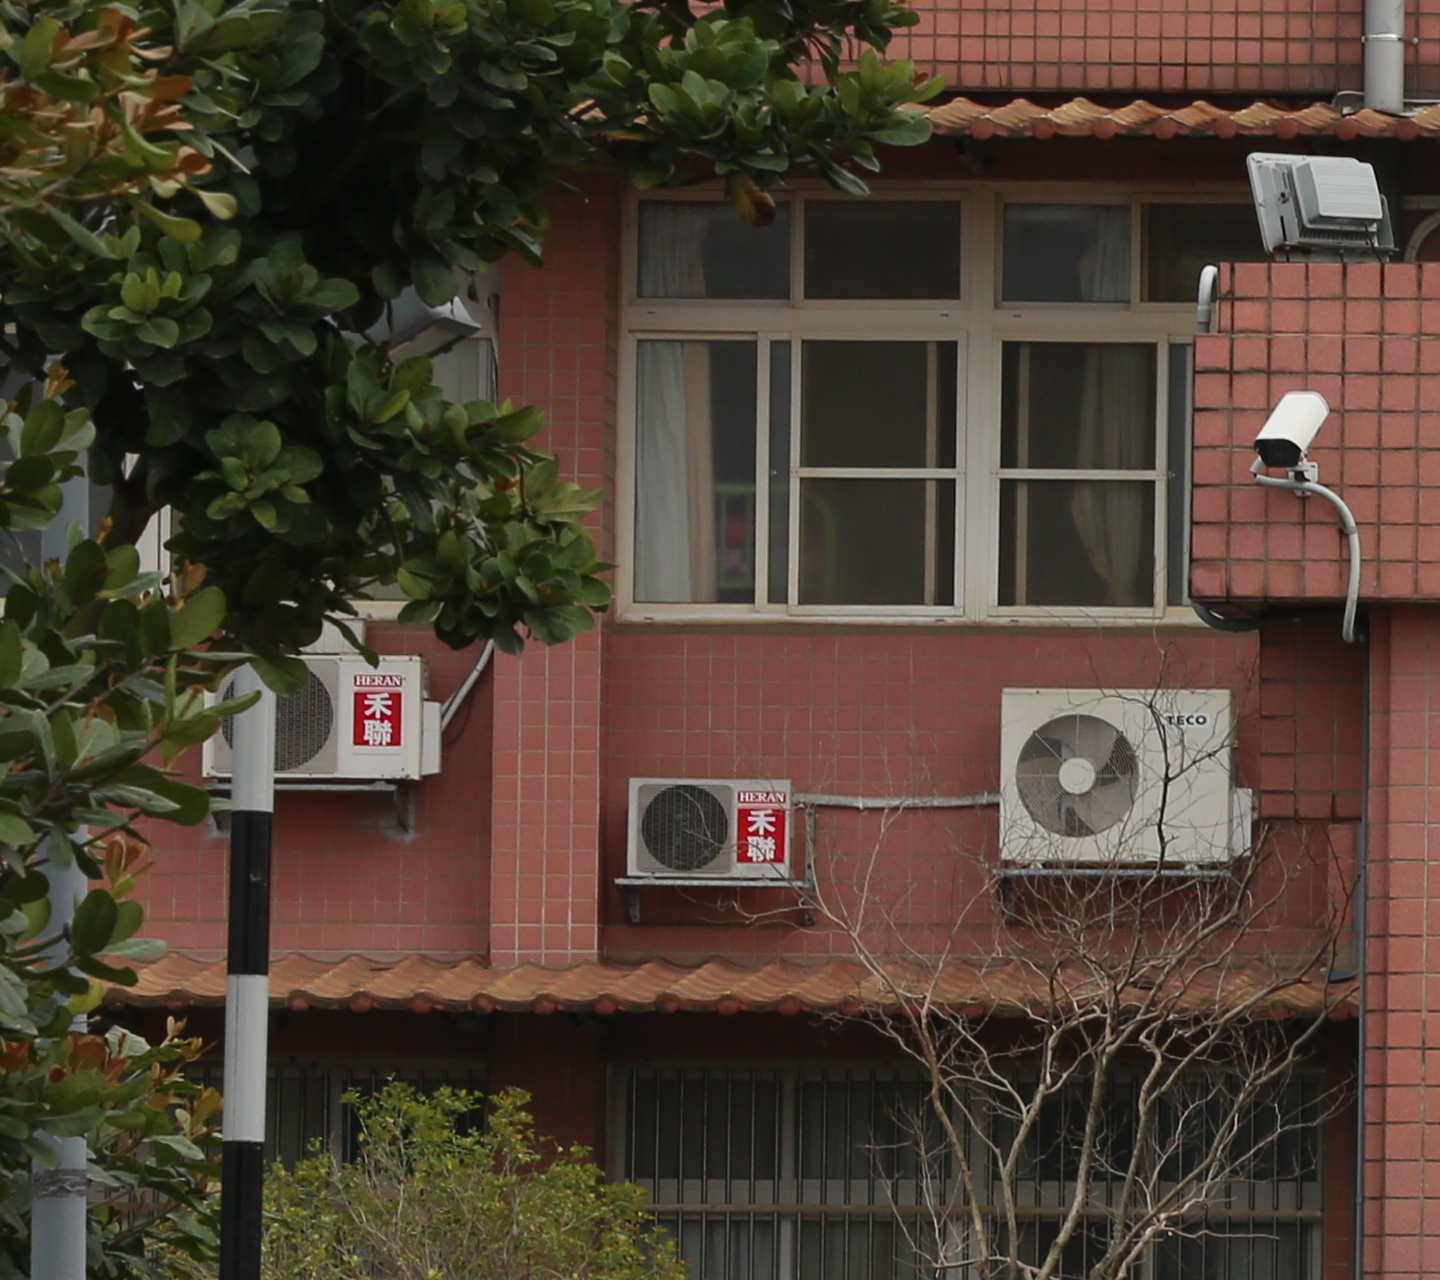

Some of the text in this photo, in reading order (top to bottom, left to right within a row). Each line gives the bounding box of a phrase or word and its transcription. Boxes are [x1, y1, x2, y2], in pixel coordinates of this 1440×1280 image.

[355, 675, 401, 686] HERAN
[363, 692, 393, 746] 禾聯
[1166, 714, 1207, 726] TECO
[739, 792, 785, 803] HERAN
[746, 809, 776, 862] 禾聯
